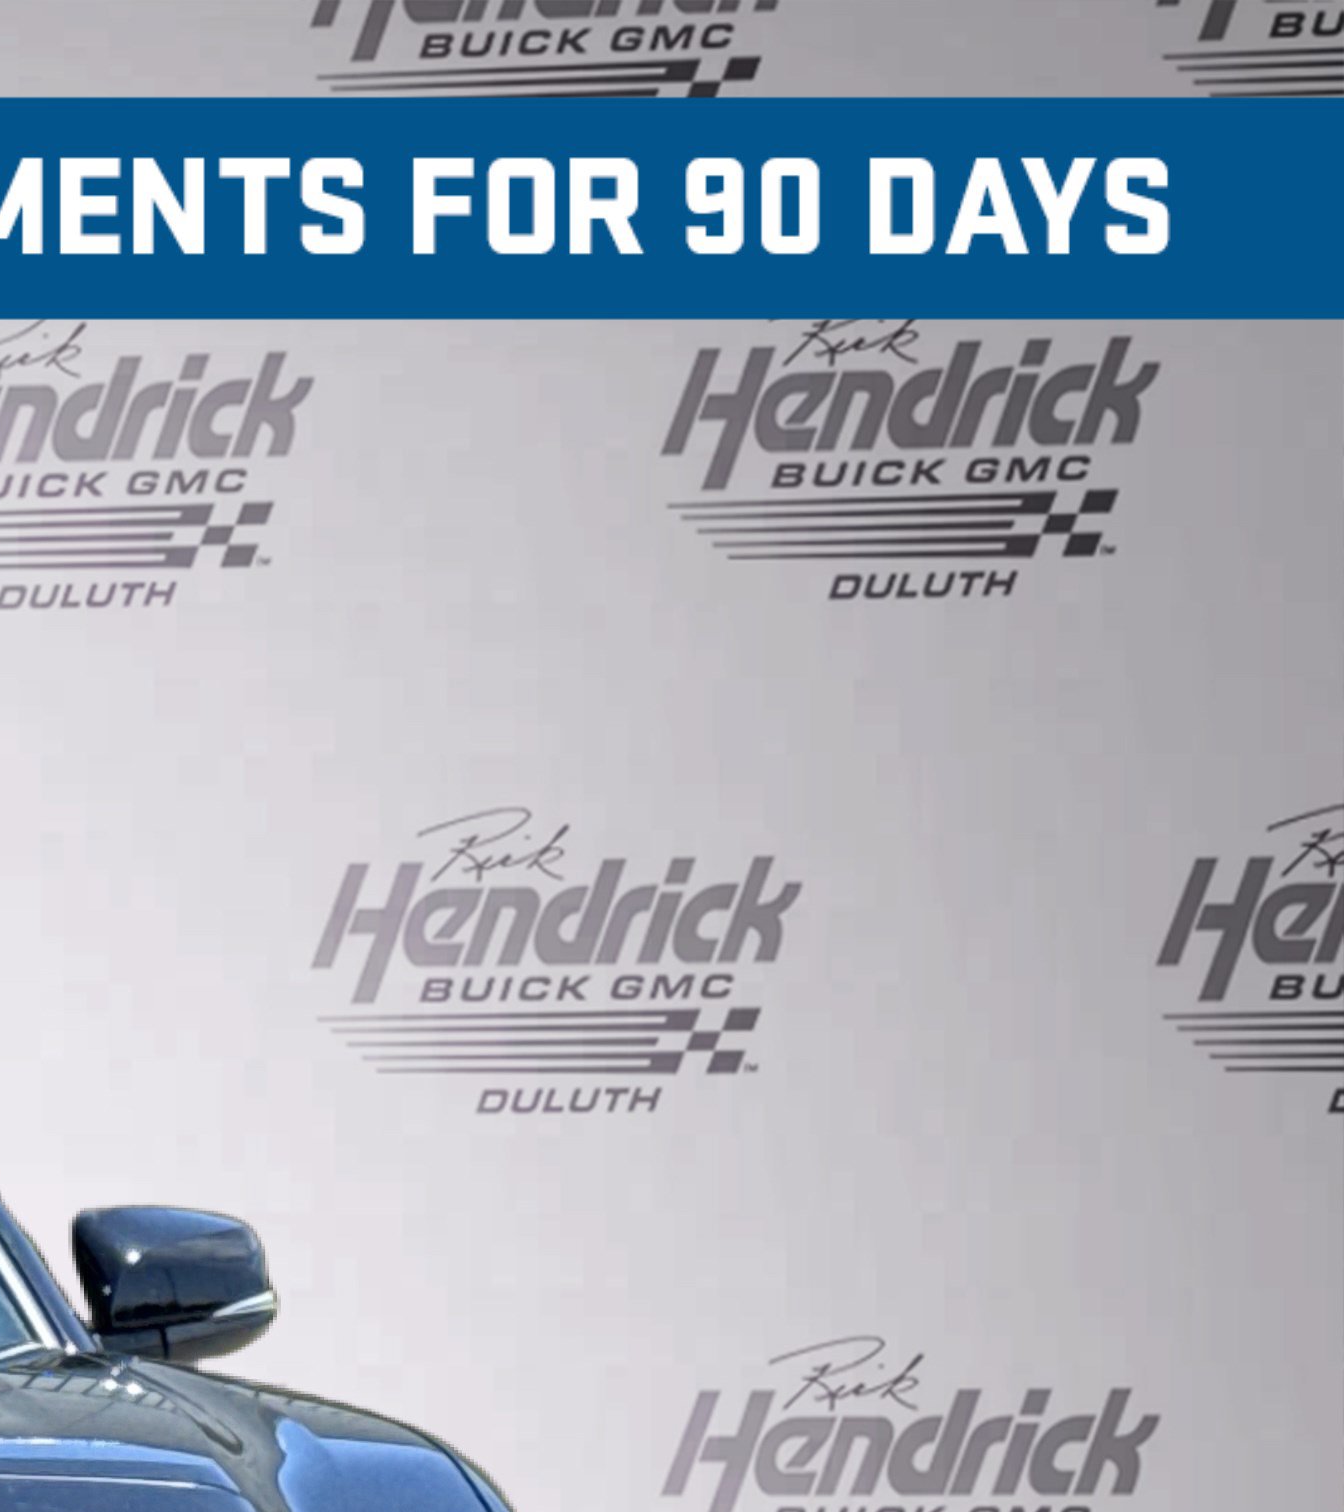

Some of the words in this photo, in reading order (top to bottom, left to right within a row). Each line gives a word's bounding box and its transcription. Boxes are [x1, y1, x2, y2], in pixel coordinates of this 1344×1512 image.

[419, 27, 592, 59] BUICK
[609, 23, 735, 53] GMC
[660, 336, 1161, 491] Hendrick
[126, 468, 248, 497] GMC
[770, 459, 946, 489] BUICK
[964, 455, 1092, 484] GMC
[828, 570, 1018, 601] DULUTH
[311, 856, 802, 1003] Hendrick
[419, 976, 592, 1002] BUICK
[610, 973, 734, 1000] GMC
[476, 1087, 661, 1114] DULUTH
